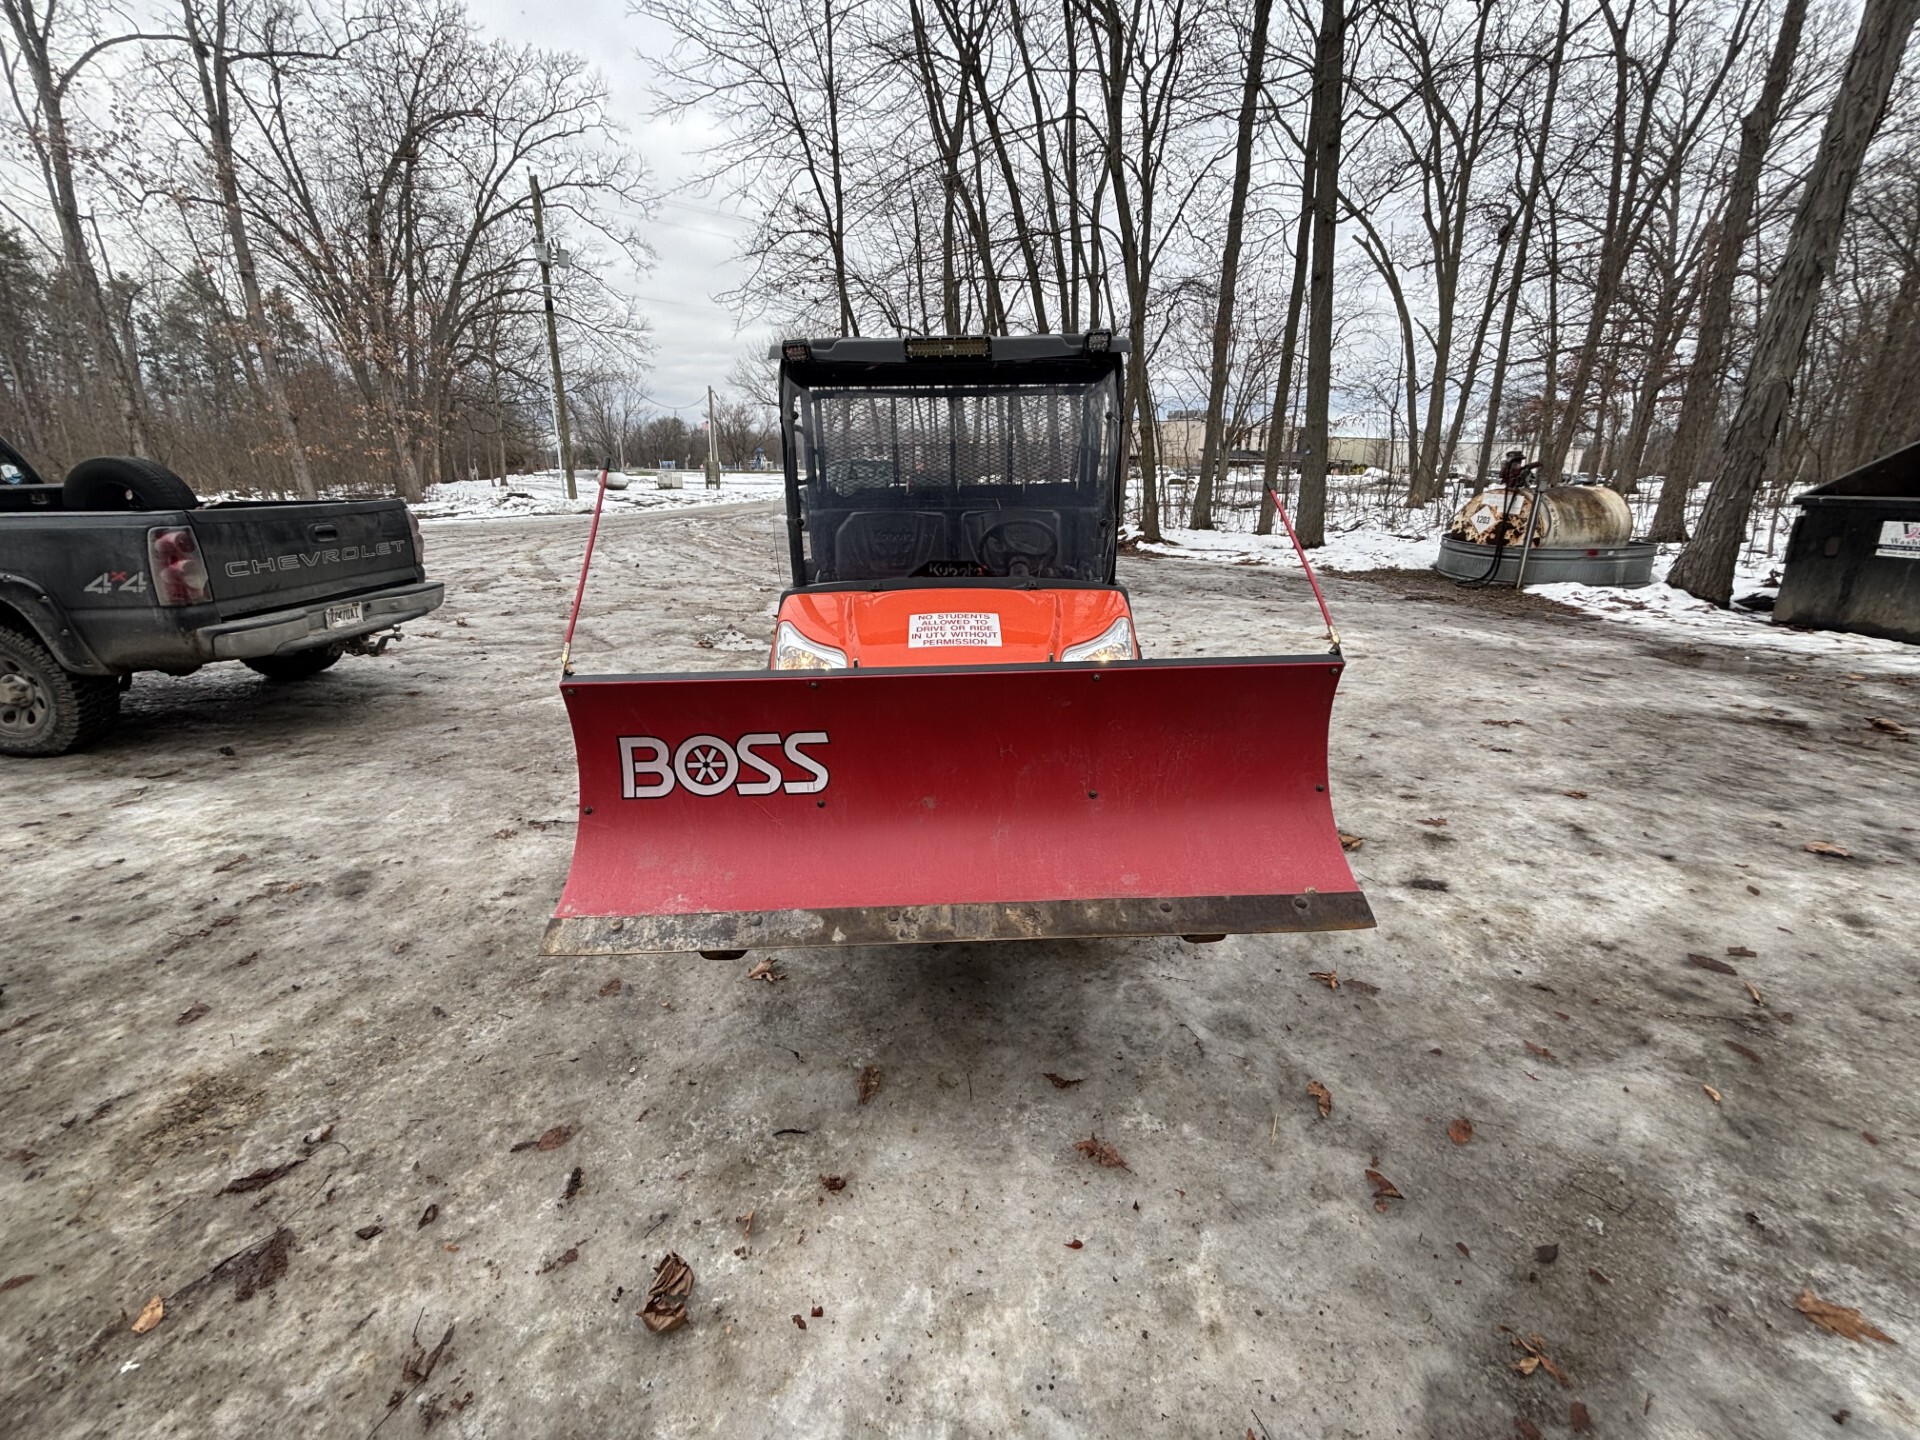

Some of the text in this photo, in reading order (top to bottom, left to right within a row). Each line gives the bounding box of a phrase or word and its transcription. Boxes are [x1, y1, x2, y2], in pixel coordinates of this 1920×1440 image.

[1476, 515, 1491, 524] 1203
[225, 539, 405, 578] CHEVROLET
[925, 631, 947, 639] UTV
[922, 638, 988, 646] PERMISSION
[616, 730, 830, 800] BOSS
